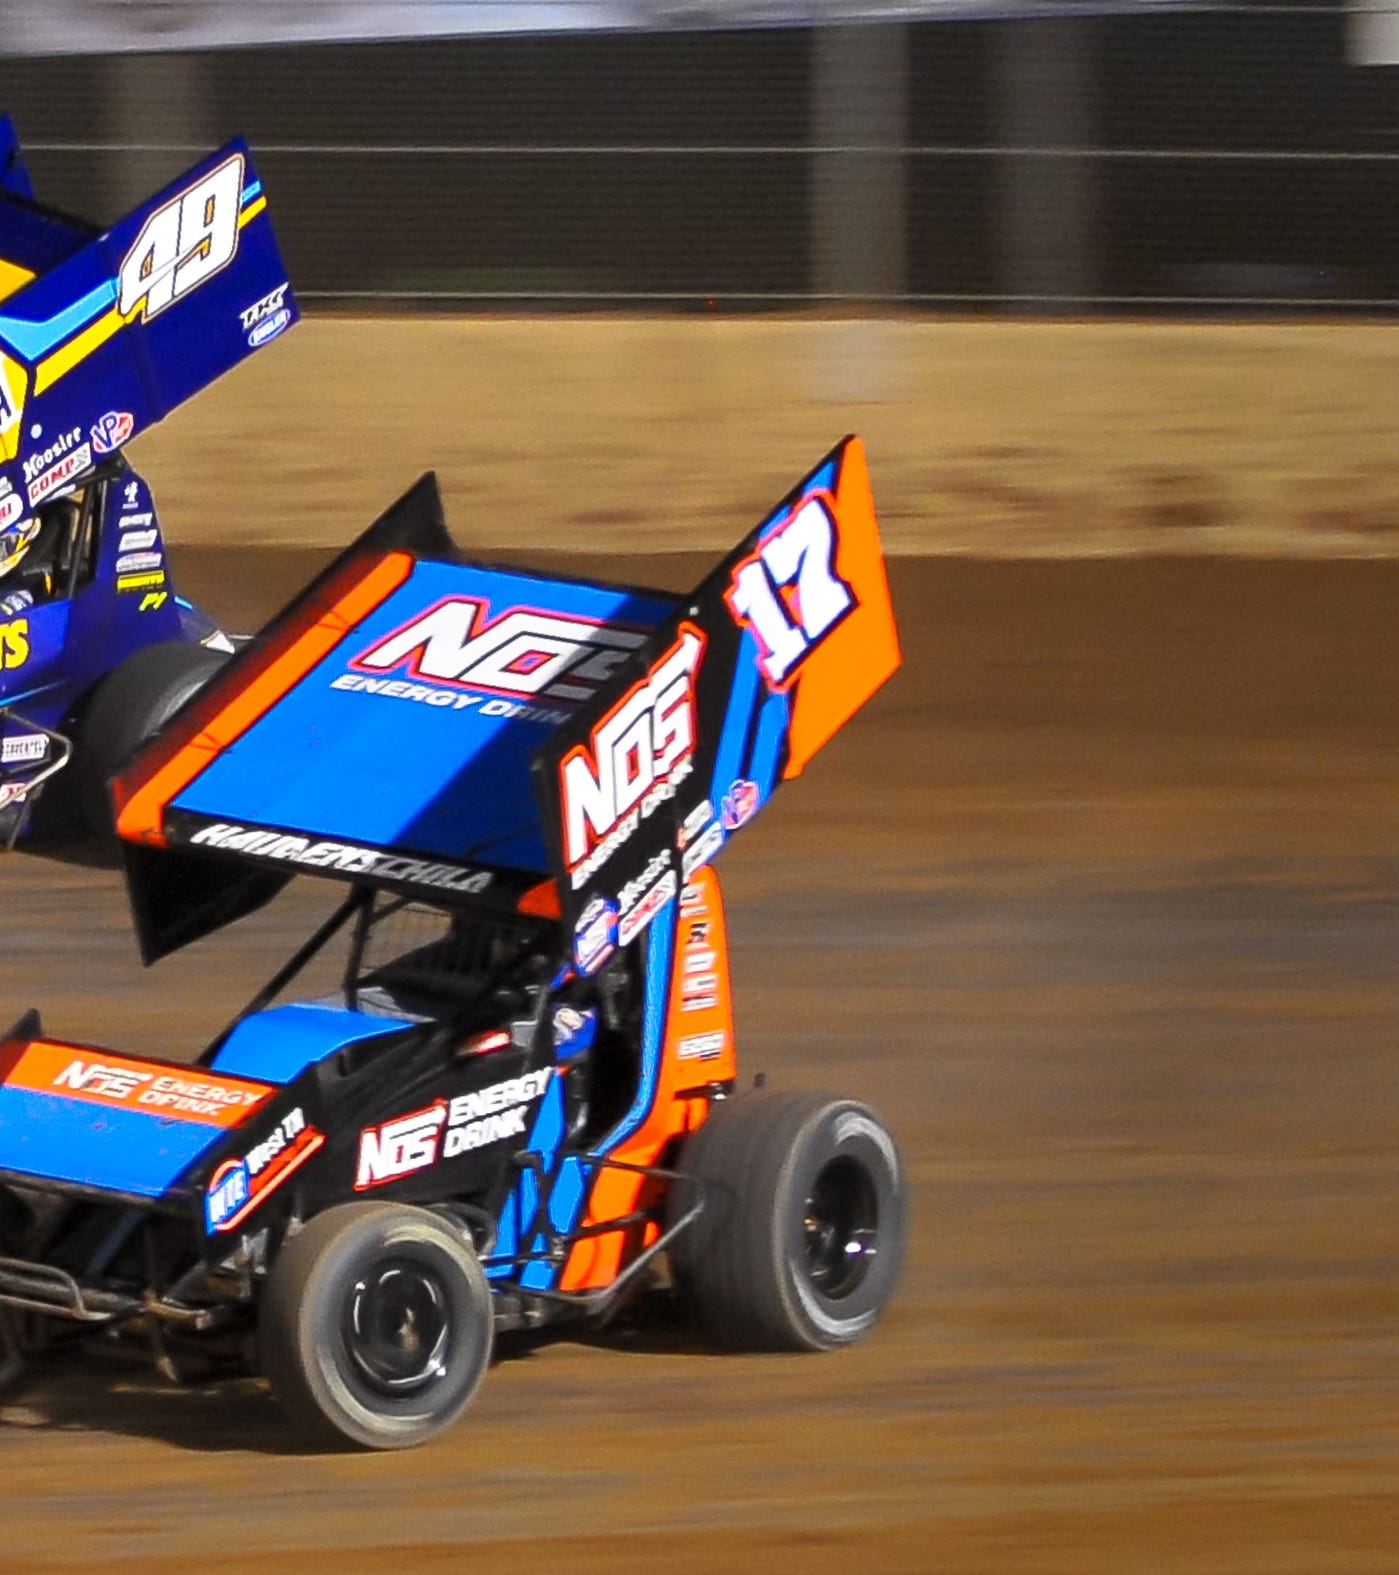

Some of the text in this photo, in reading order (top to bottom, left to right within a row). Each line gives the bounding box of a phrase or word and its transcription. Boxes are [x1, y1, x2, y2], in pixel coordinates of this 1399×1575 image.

[116, 153, 245, 325] 49
[728, 493, 857, 687] 17
[330, 674, 481, 711] ENERGY
[561, 626, 705, 870] NOS
[53, 1060, 266, 1105] NOS ENERGY
[137, 1090, 228, 1116] DRINK
[355, 1102, 448, 1189] NOS
[448, 1065, 553, 1126] ENERGY
[443, 1104, 529, 1158] DRINK
